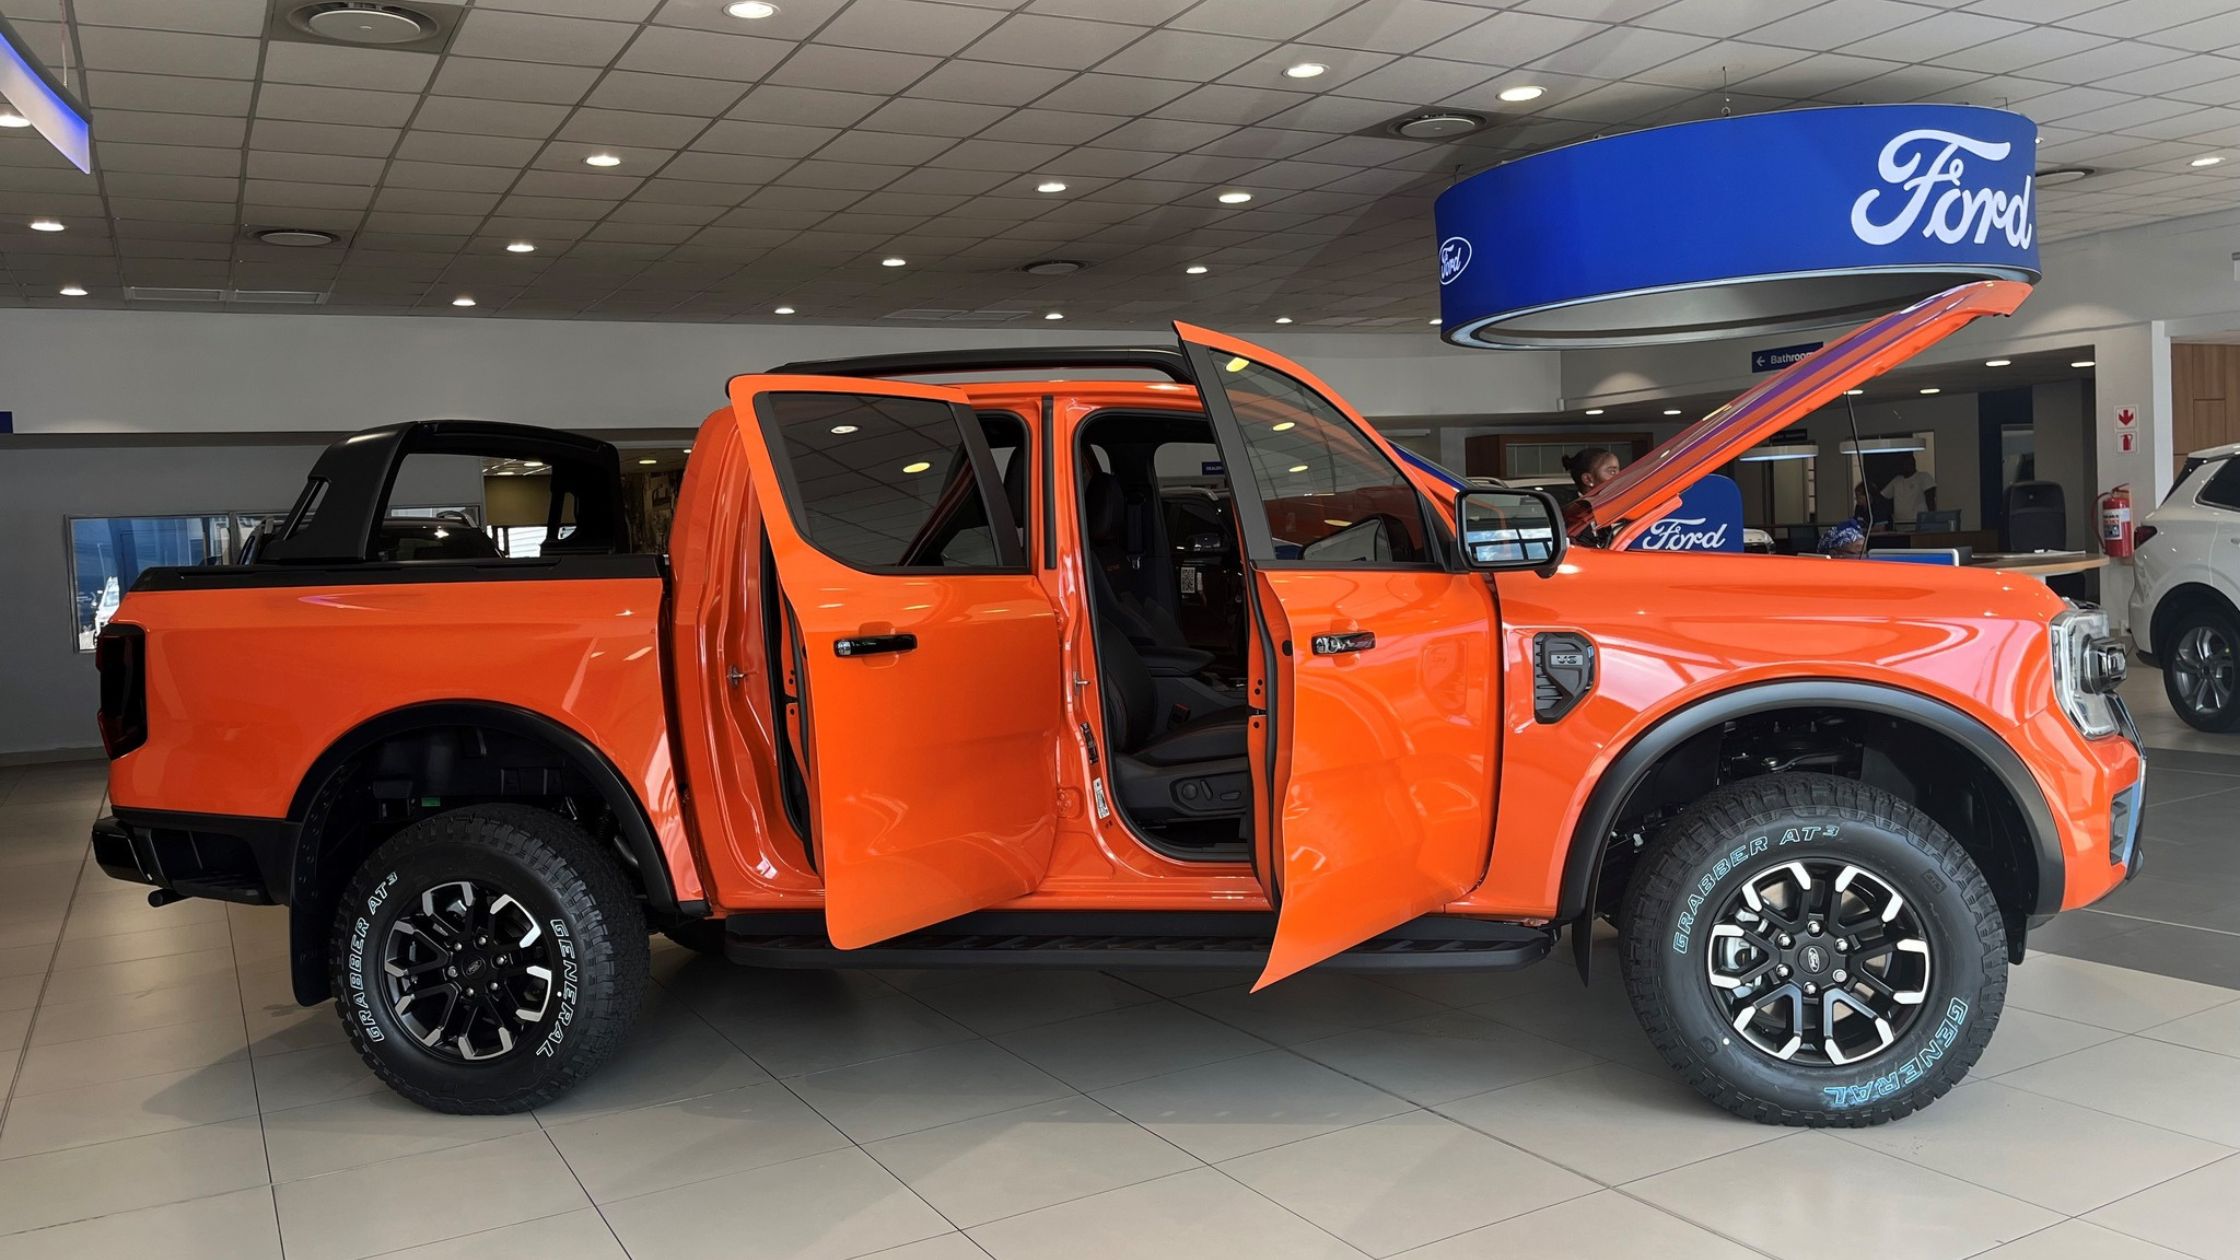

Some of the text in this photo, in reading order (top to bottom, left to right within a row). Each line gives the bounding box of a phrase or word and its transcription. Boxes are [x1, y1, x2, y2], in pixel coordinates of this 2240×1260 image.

[1851, 129, 2032, 250] Ford
[1642, 517, 1728, 550] Ford
[1672, 836, 1769, 954] GRABBER
[349, 916, 385, 1042] GRABBER
[535, 919, 578, 1058] GENERAL
[1823, 997, 1969, 1106] GENERAL
